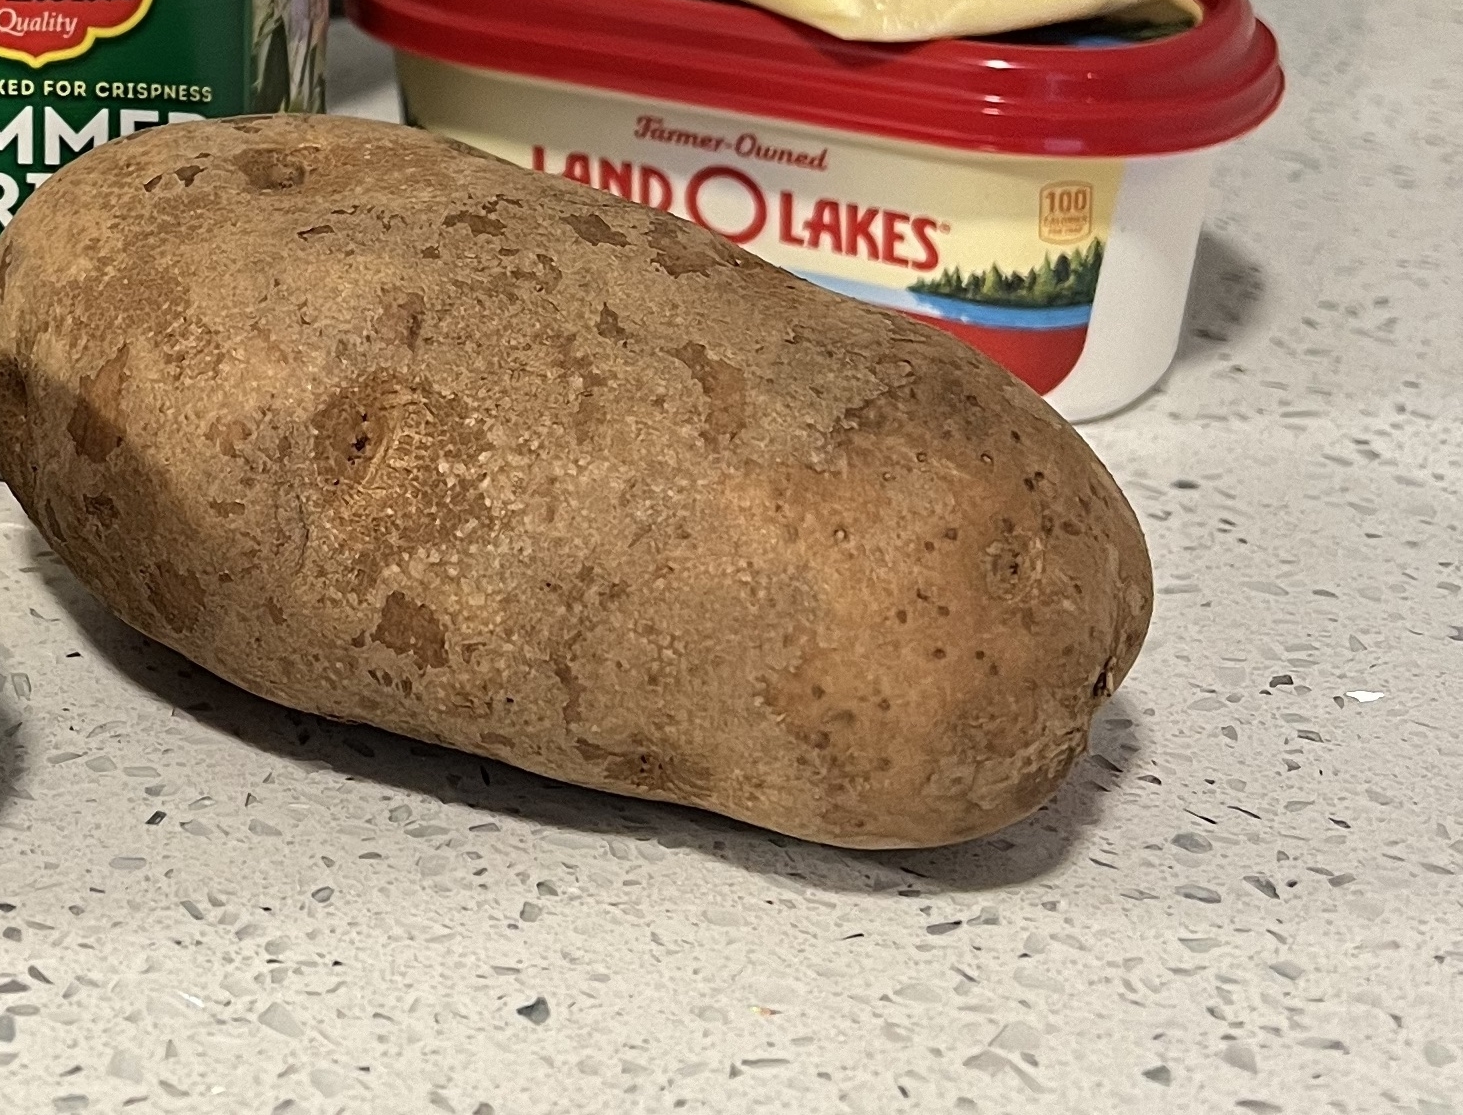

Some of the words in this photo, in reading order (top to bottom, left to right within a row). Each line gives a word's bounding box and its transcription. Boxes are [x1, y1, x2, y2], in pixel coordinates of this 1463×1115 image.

[43, 80, 87, 97] FOR
[95, 82, 212, 102] CRISPNESS
[634, 114, 829, 172] Farmer-Owned
[685, 165, 767, 245] O
[780, 190, 939, 272] LAKES
[1046, 189, 1087, 214] 100
